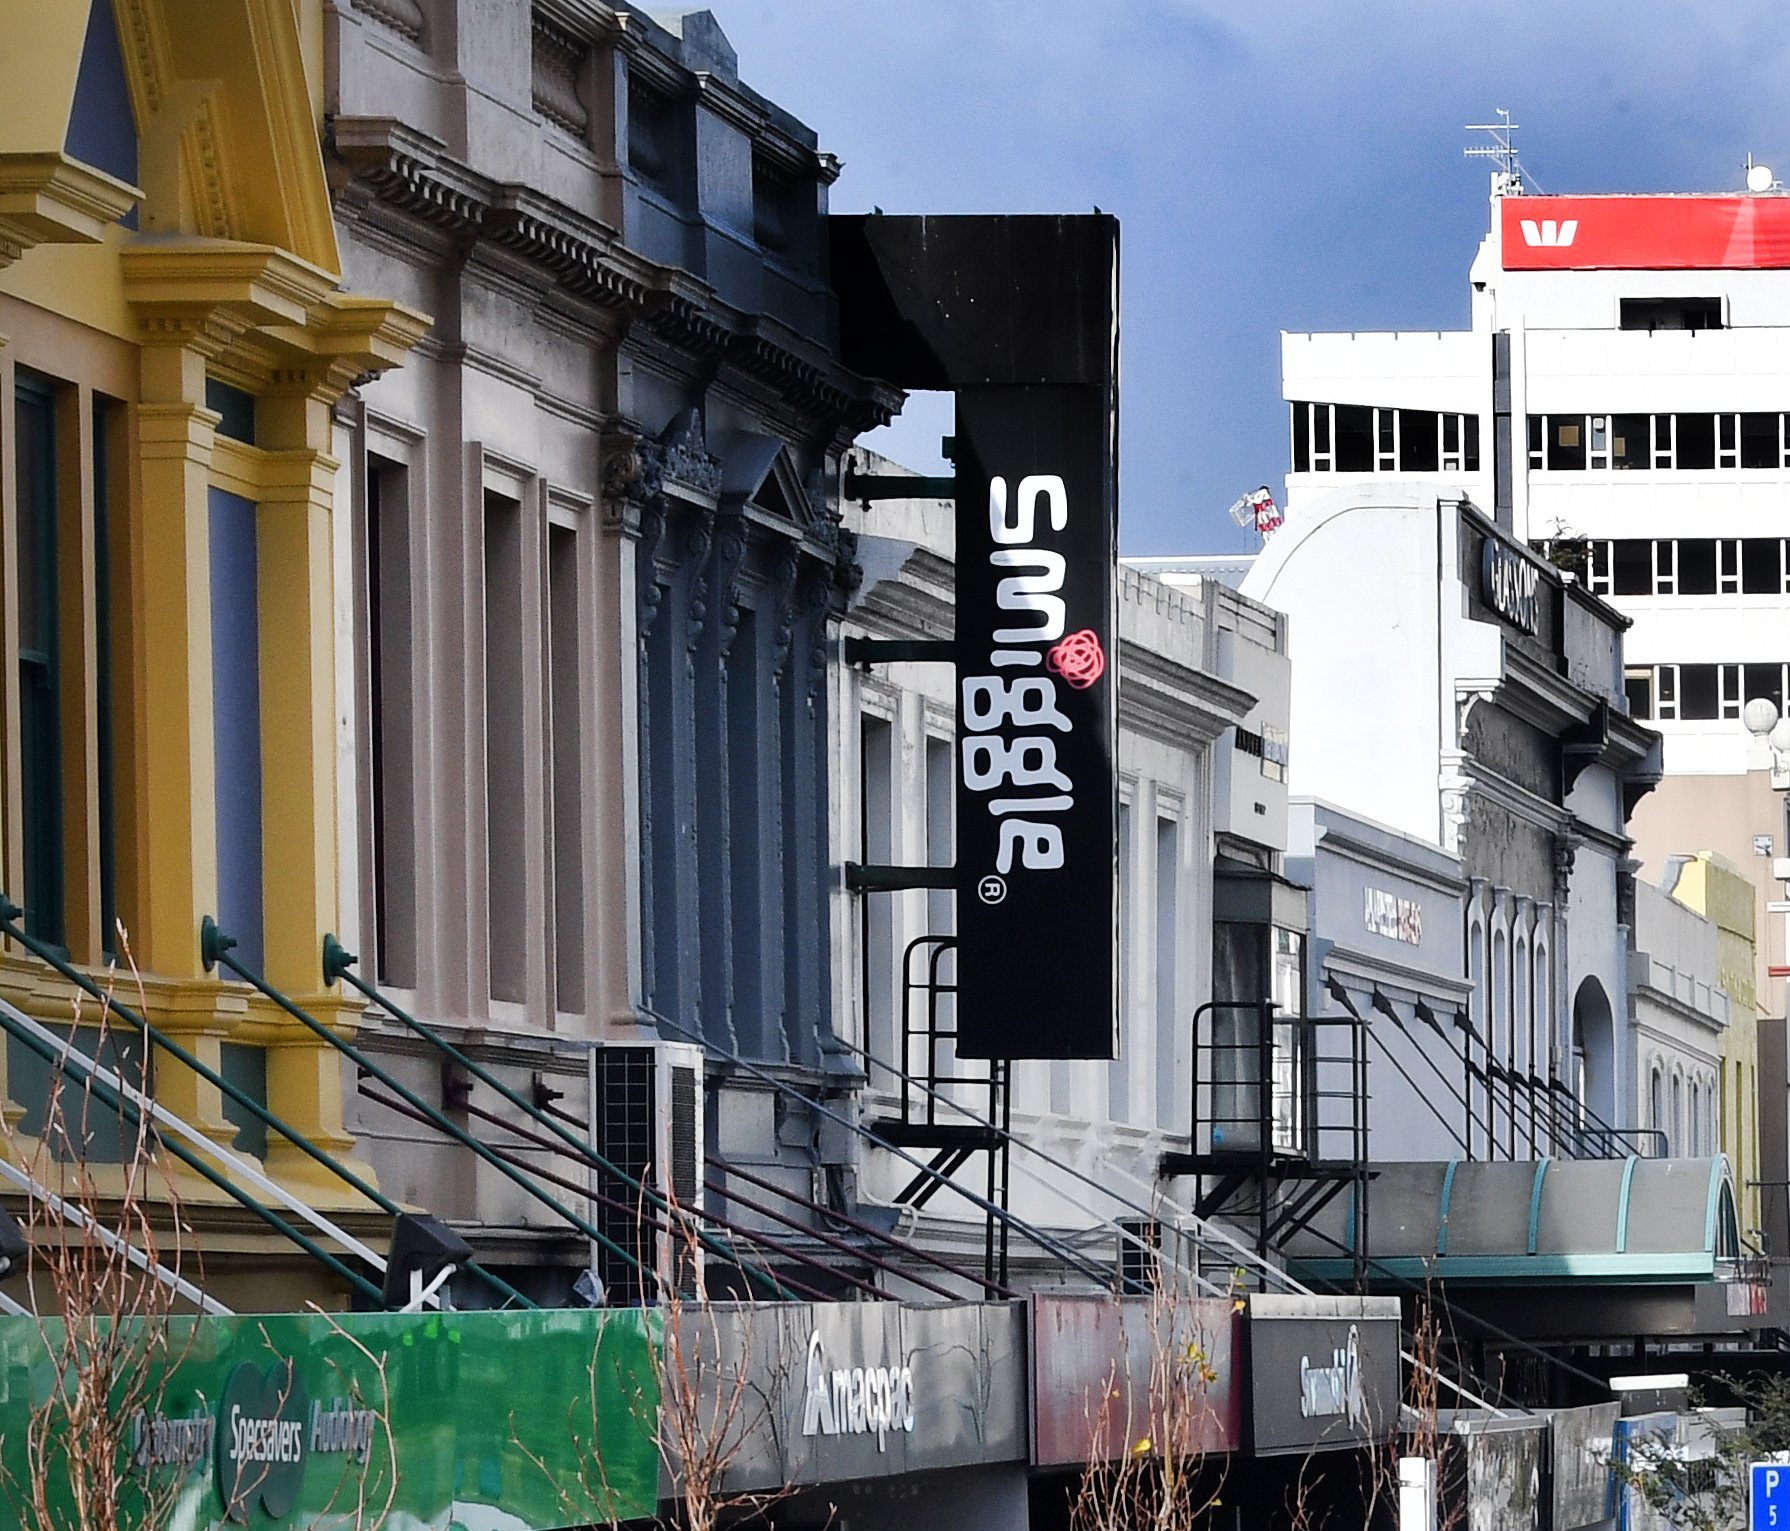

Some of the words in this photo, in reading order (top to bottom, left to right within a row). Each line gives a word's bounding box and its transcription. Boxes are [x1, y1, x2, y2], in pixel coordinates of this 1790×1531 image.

[962, 474, 1074, 874] smiggle
[230, 1403, 302, 1463] Specsavers
[832, 1365, 914, 1453] macpac
[1766, 1470, 1779, 1498] P
[1769, 1505, 1777, 1526] 5
